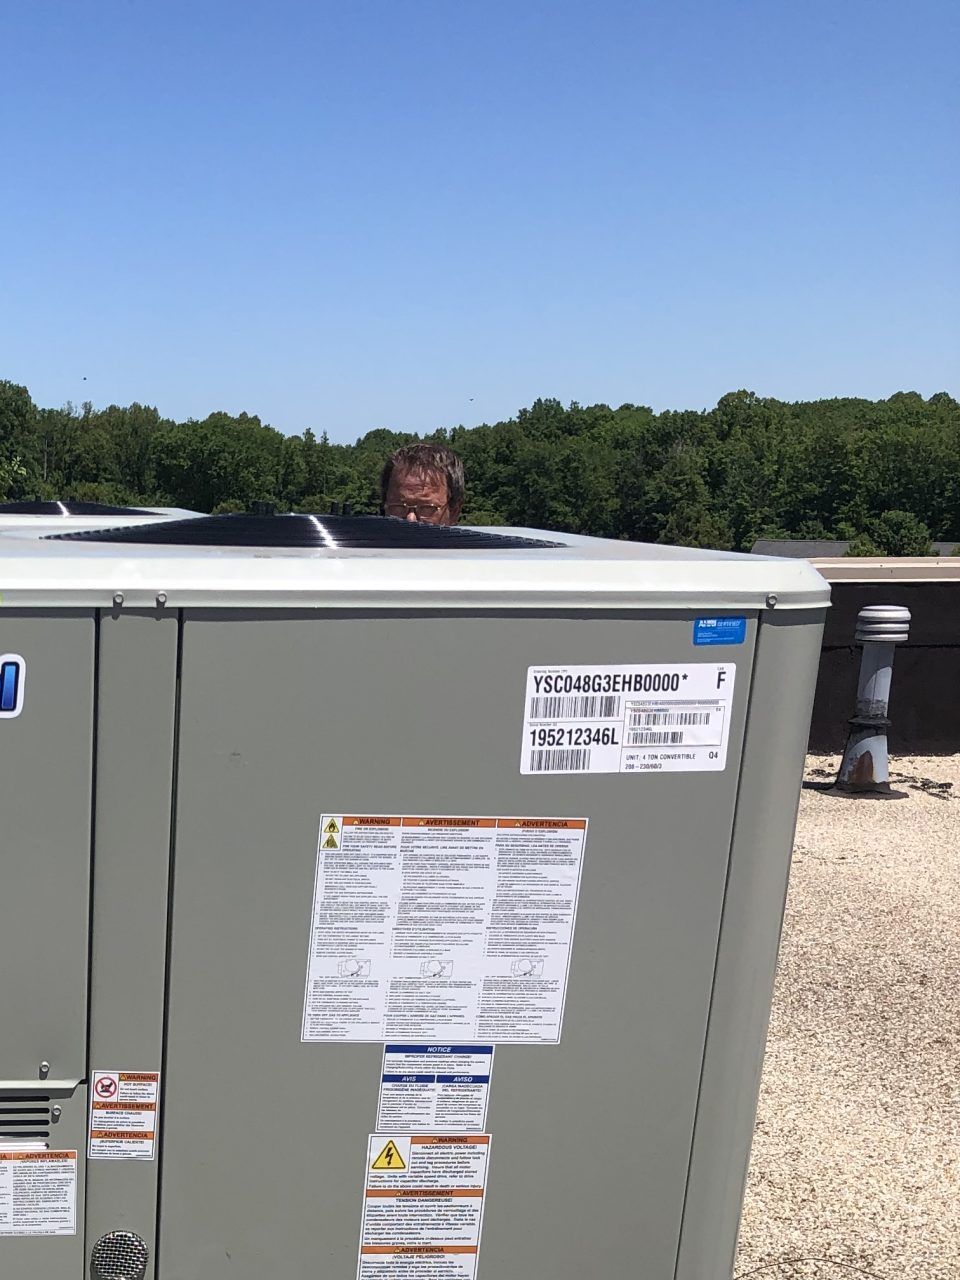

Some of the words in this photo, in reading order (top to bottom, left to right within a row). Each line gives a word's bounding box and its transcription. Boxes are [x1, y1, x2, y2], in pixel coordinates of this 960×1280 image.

[716, 671, 726, 690] F
[530, 728, 619, 746] 195212346L
[359, 818, 390, 826] WARNING
